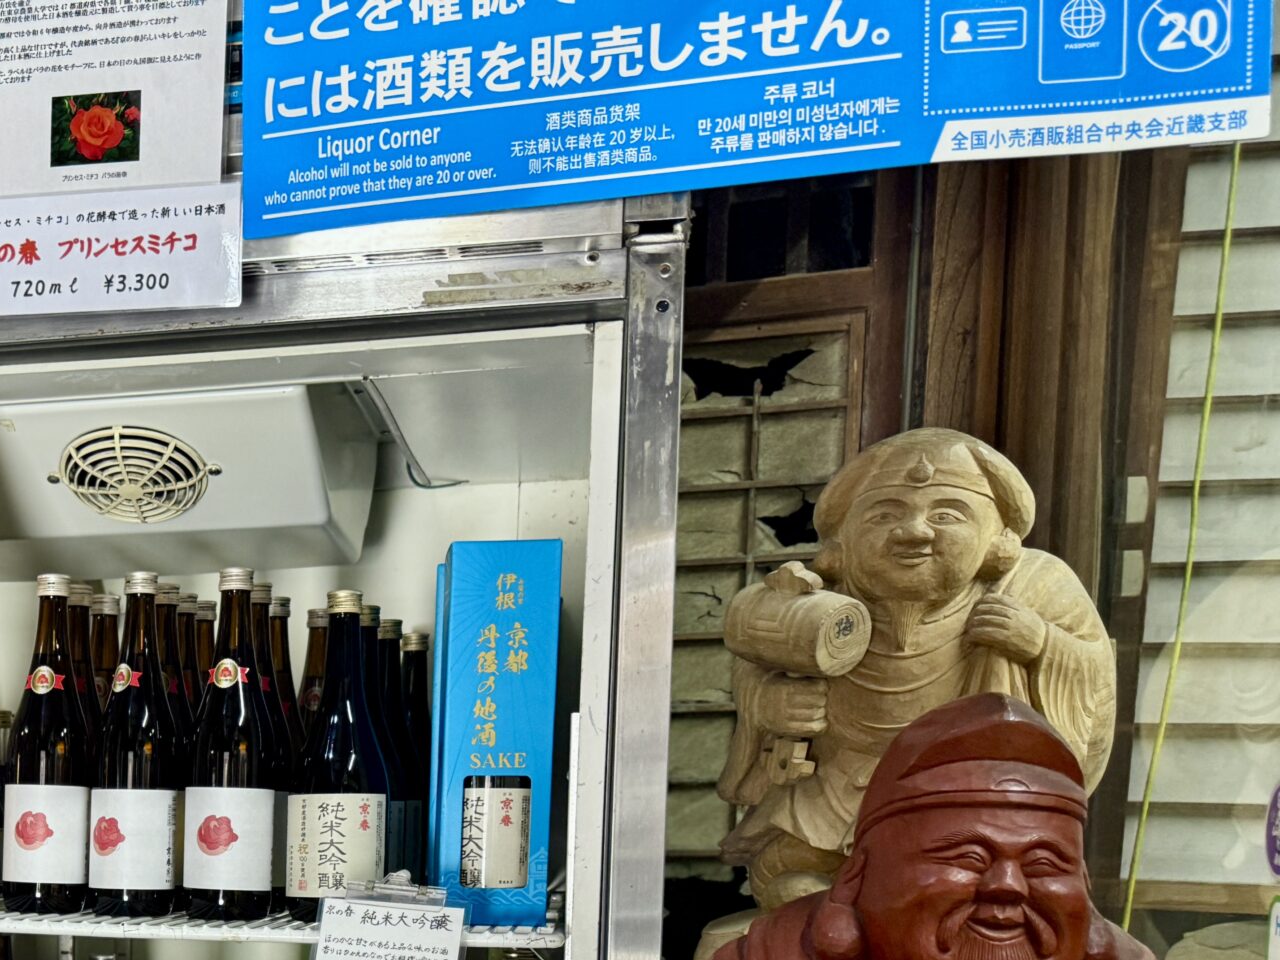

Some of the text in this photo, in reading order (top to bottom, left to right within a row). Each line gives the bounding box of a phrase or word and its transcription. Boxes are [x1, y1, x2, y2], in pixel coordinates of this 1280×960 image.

[1065, 41, 1101, 50] PASSPORT
[1157, 9, 1219, 51] 20
[264, 0, 891, 123] には酒類を販売しません。
[764, 78, 835, 106] 주류 코너
[546, 103, 640, 132] 酒类商品货架
[698, 97, 900, 136] 만 20세 미만의 미성년자에게는
[951, 110, 1248, 152] 全国小売酒販組合中央会近畿支部
[318, 125, 441, 161] Liquor Corner
[510, 130, 605, 158] 无法确认年龄在
[609, 130, 626, 146] 20
[711, 127, 816, 155] 주류를 판매하지
[288, 151, 471, 185] Alcohol will not be sold to anyone
[528, 146, 658, 175] 则不能出售酒类商品。
[265, 166, 496, 206] who cannot prove that they are 20 or over.
[58, 232, 198, 260] プリンセスミチコ
[496, 573, 518, 611] 伊根
[505, 622, 528, 672] 京都
[471, 624, 500, 748] 丹後の地酒
[470, 753, 526, 769] SAKE
[318, 802, 347, 890] 純米大吟醸
[325, 904, 453, 932] 京の春 純米大吟醸
